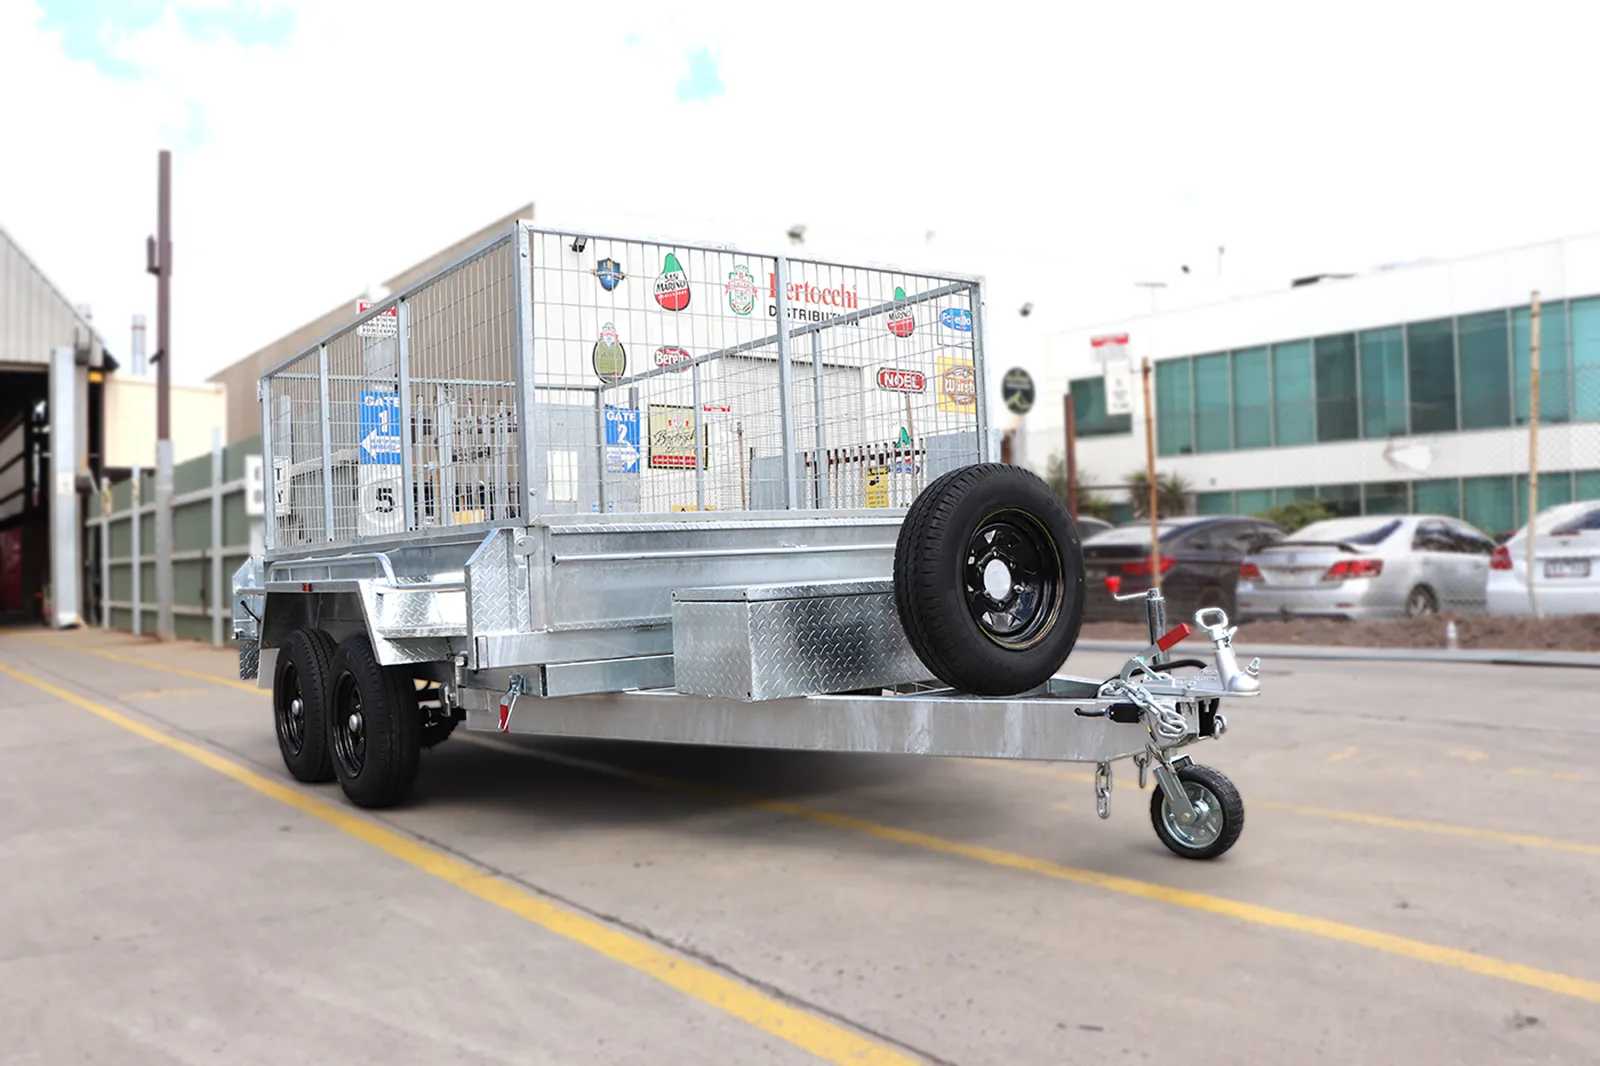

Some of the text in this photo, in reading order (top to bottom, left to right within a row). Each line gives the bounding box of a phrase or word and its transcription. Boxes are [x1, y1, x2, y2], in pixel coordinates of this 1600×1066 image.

[656, 281, 686, 292] MARINO
[664, 273, 679, 283] SAN
[769, 305, 859, 327] DSTRIBUT
[884, 372, 920, 389] NOEL
[364, 395, 400, 407] GATE
[379, 410, 388, 433] 1
[606, 410, 637, 422] GATE
[617, 423, 628, 443] 2
[376, 487, 395, 513] 5
